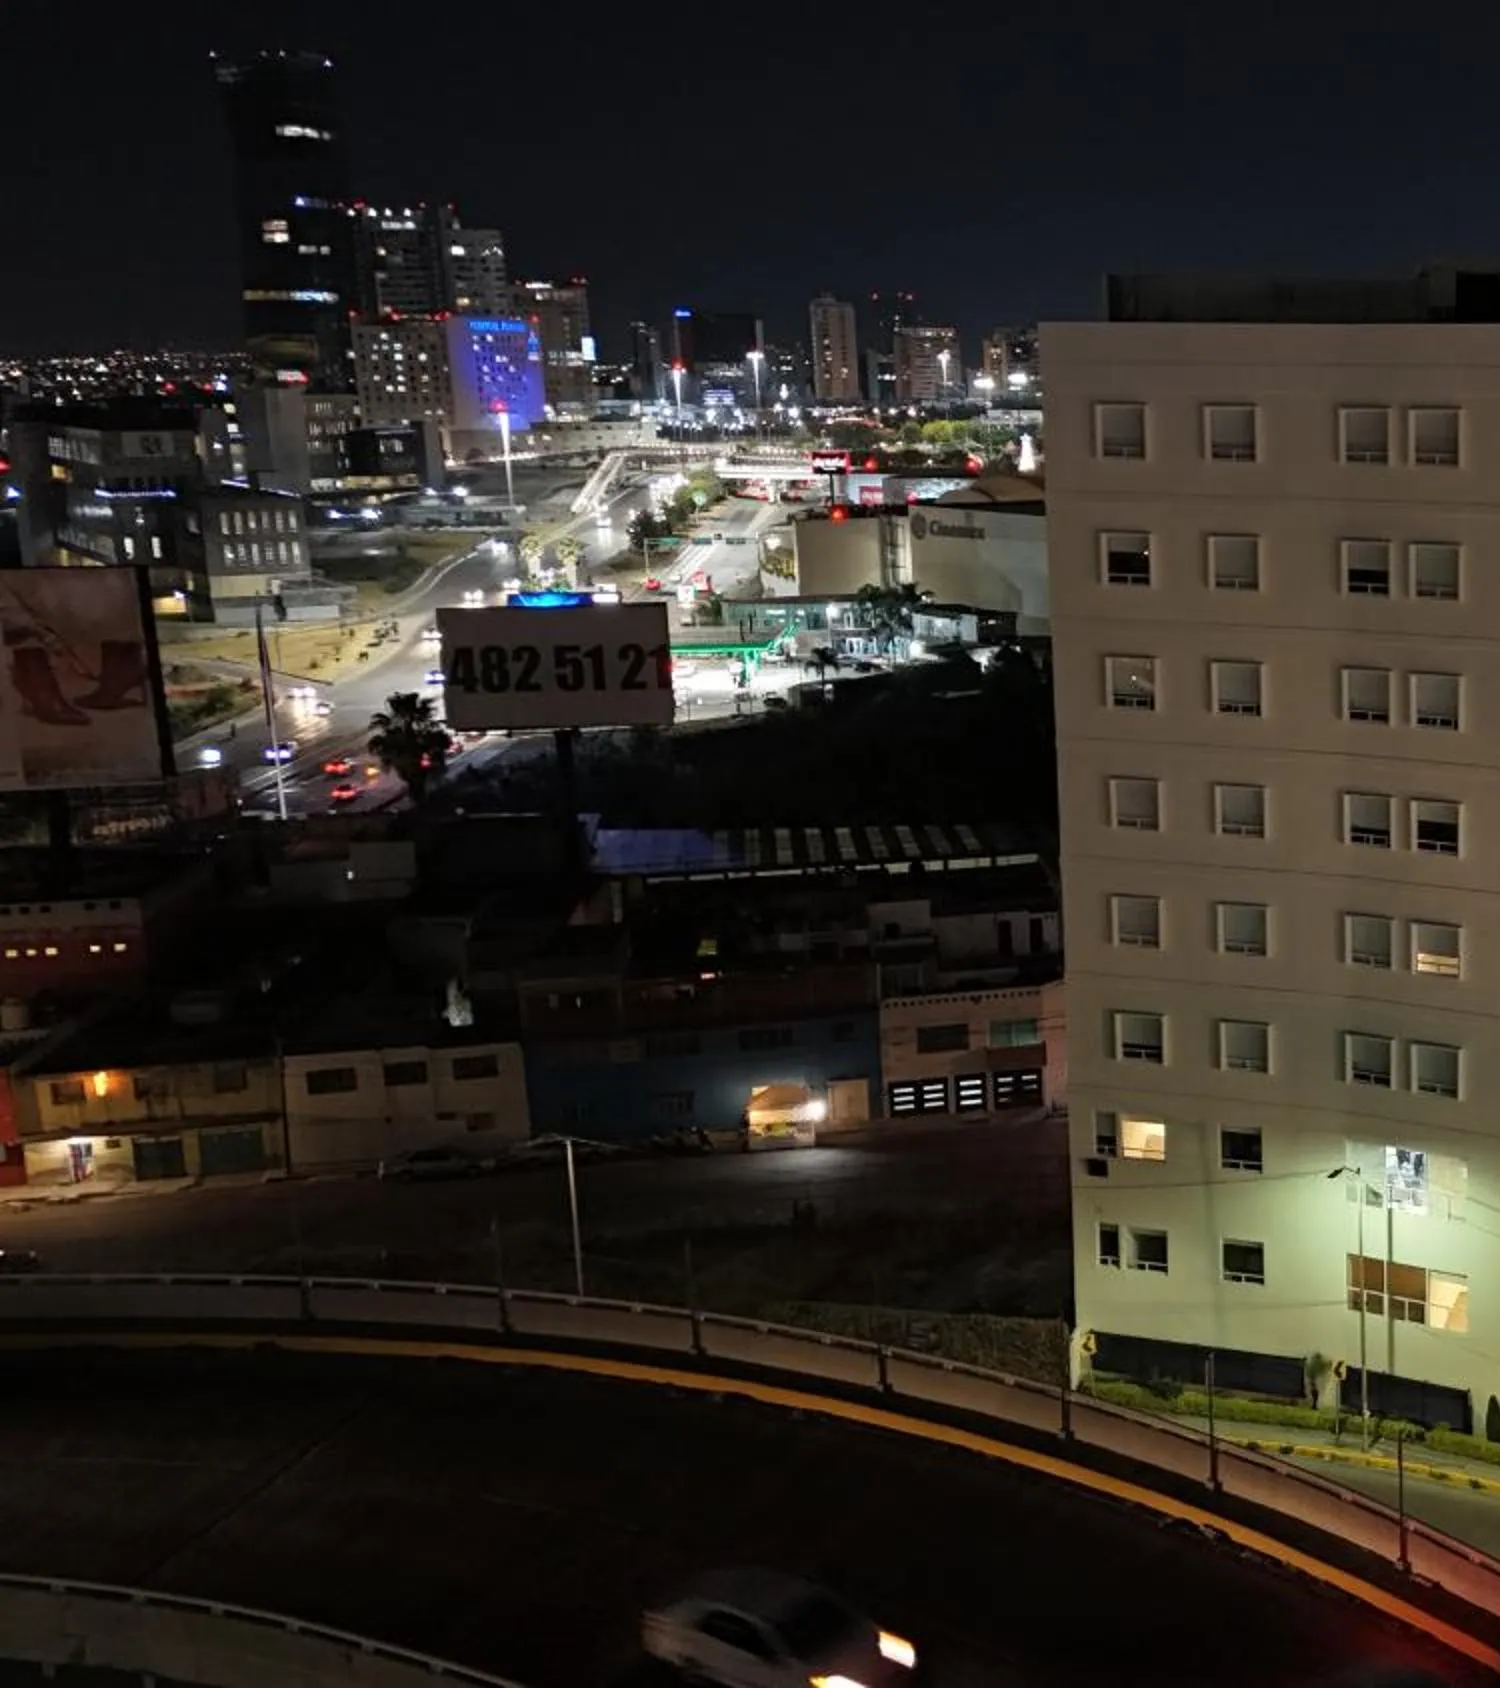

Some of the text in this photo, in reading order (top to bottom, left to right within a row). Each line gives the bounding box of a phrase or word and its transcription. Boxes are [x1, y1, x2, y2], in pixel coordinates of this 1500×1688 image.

[450, 643, 671, 693] 482 51 21
